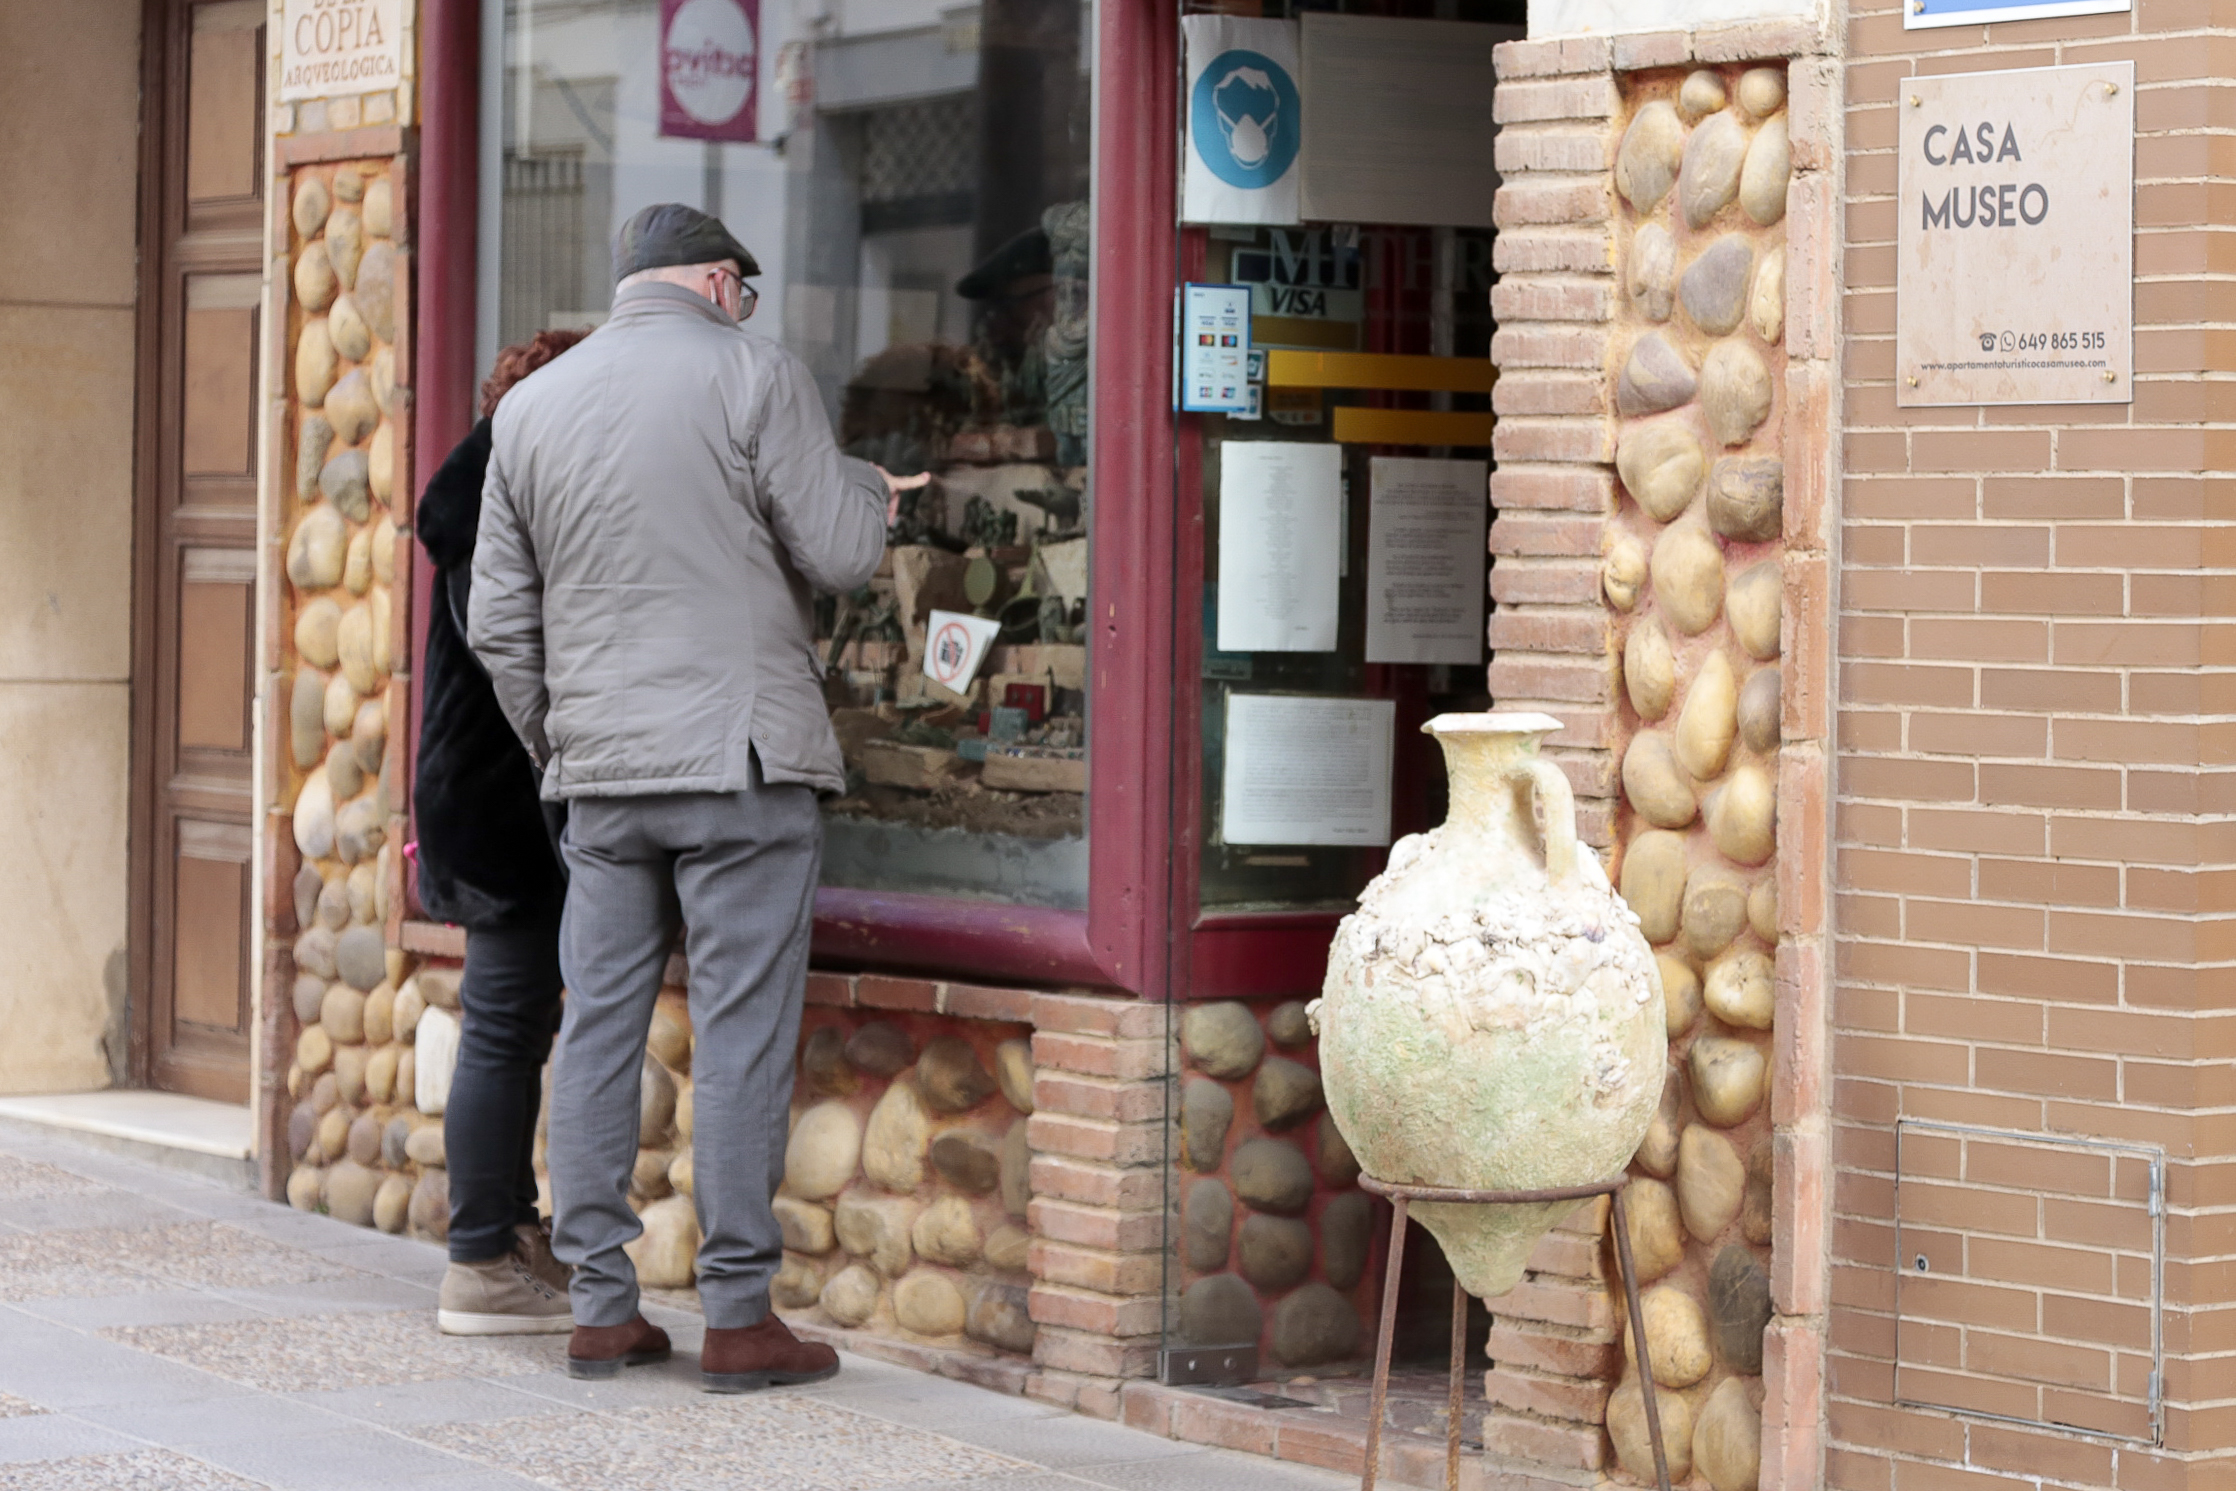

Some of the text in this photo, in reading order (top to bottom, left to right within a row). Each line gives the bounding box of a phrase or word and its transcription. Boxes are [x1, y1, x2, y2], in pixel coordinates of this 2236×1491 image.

[296, 7, 384, 55] COPIA
[1923, 121, 2022, 166] CASA
[1922, 183, 2049, 230] MUSEO
[1271, 286, 1327, 316] VISA
[2018, 331, 2106, 350] 649 865 515
[1921, 358, 2106, 373] www.apartamentoturisticocasamuseo.com
